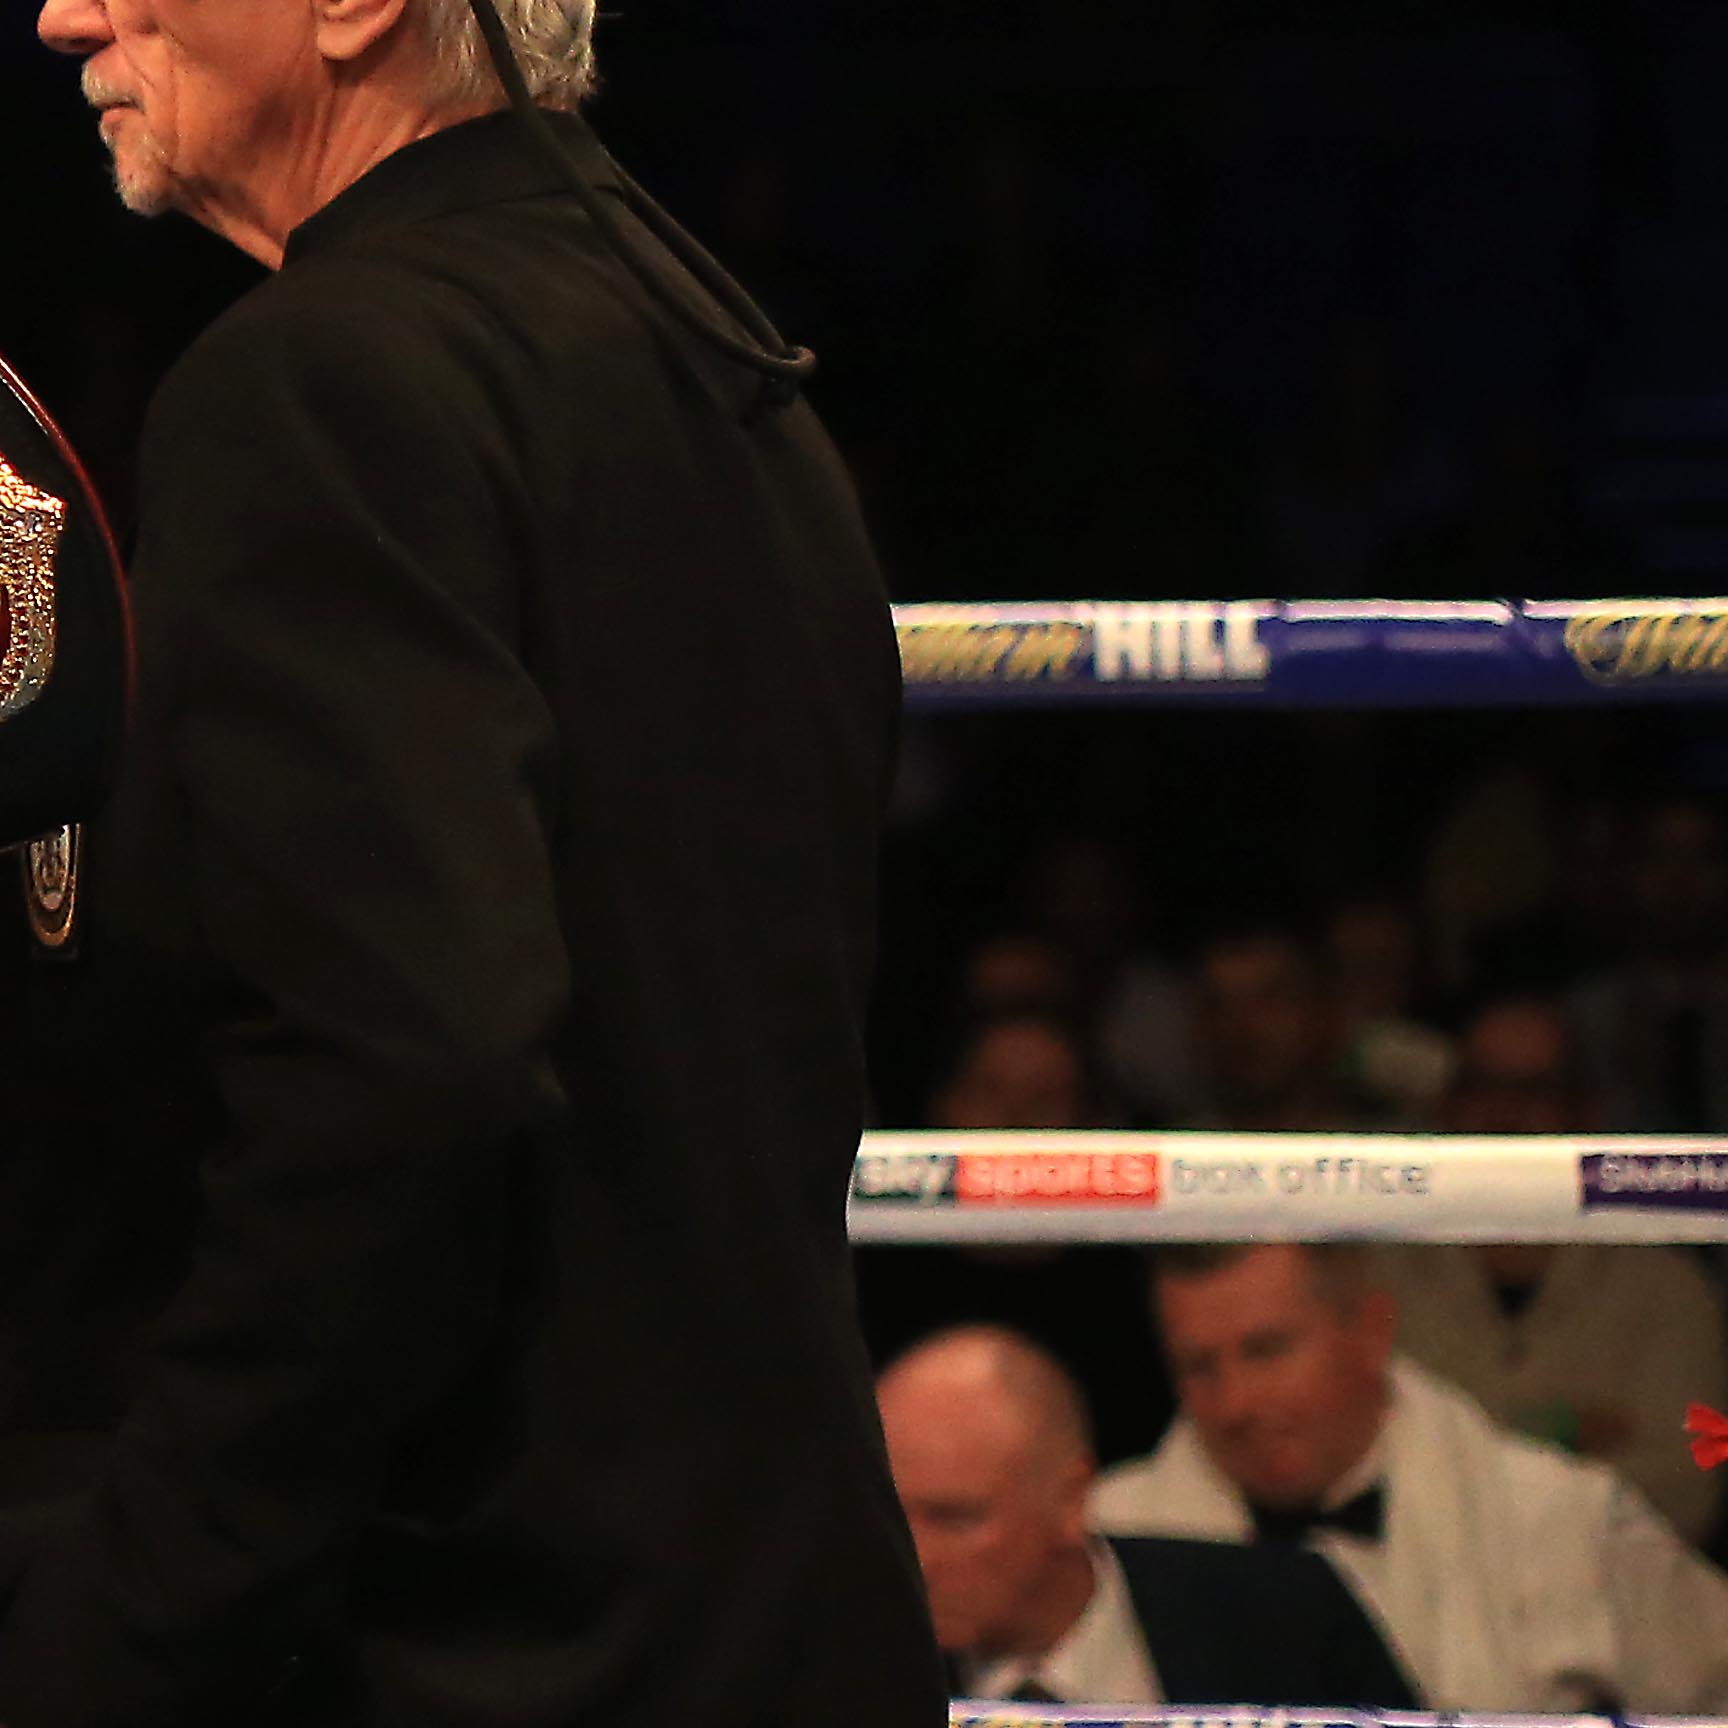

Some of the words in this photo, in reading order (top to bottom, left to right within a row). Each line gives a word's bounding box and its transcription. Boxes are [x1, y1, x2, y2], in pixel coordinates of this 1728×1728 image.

[1095, 602, 1271, 680] HILL
[959, 1155, 1159, 1206] sports
[1171, 1158, 1266, 1194] box
[1276, 1157, 1432, 1195] office
